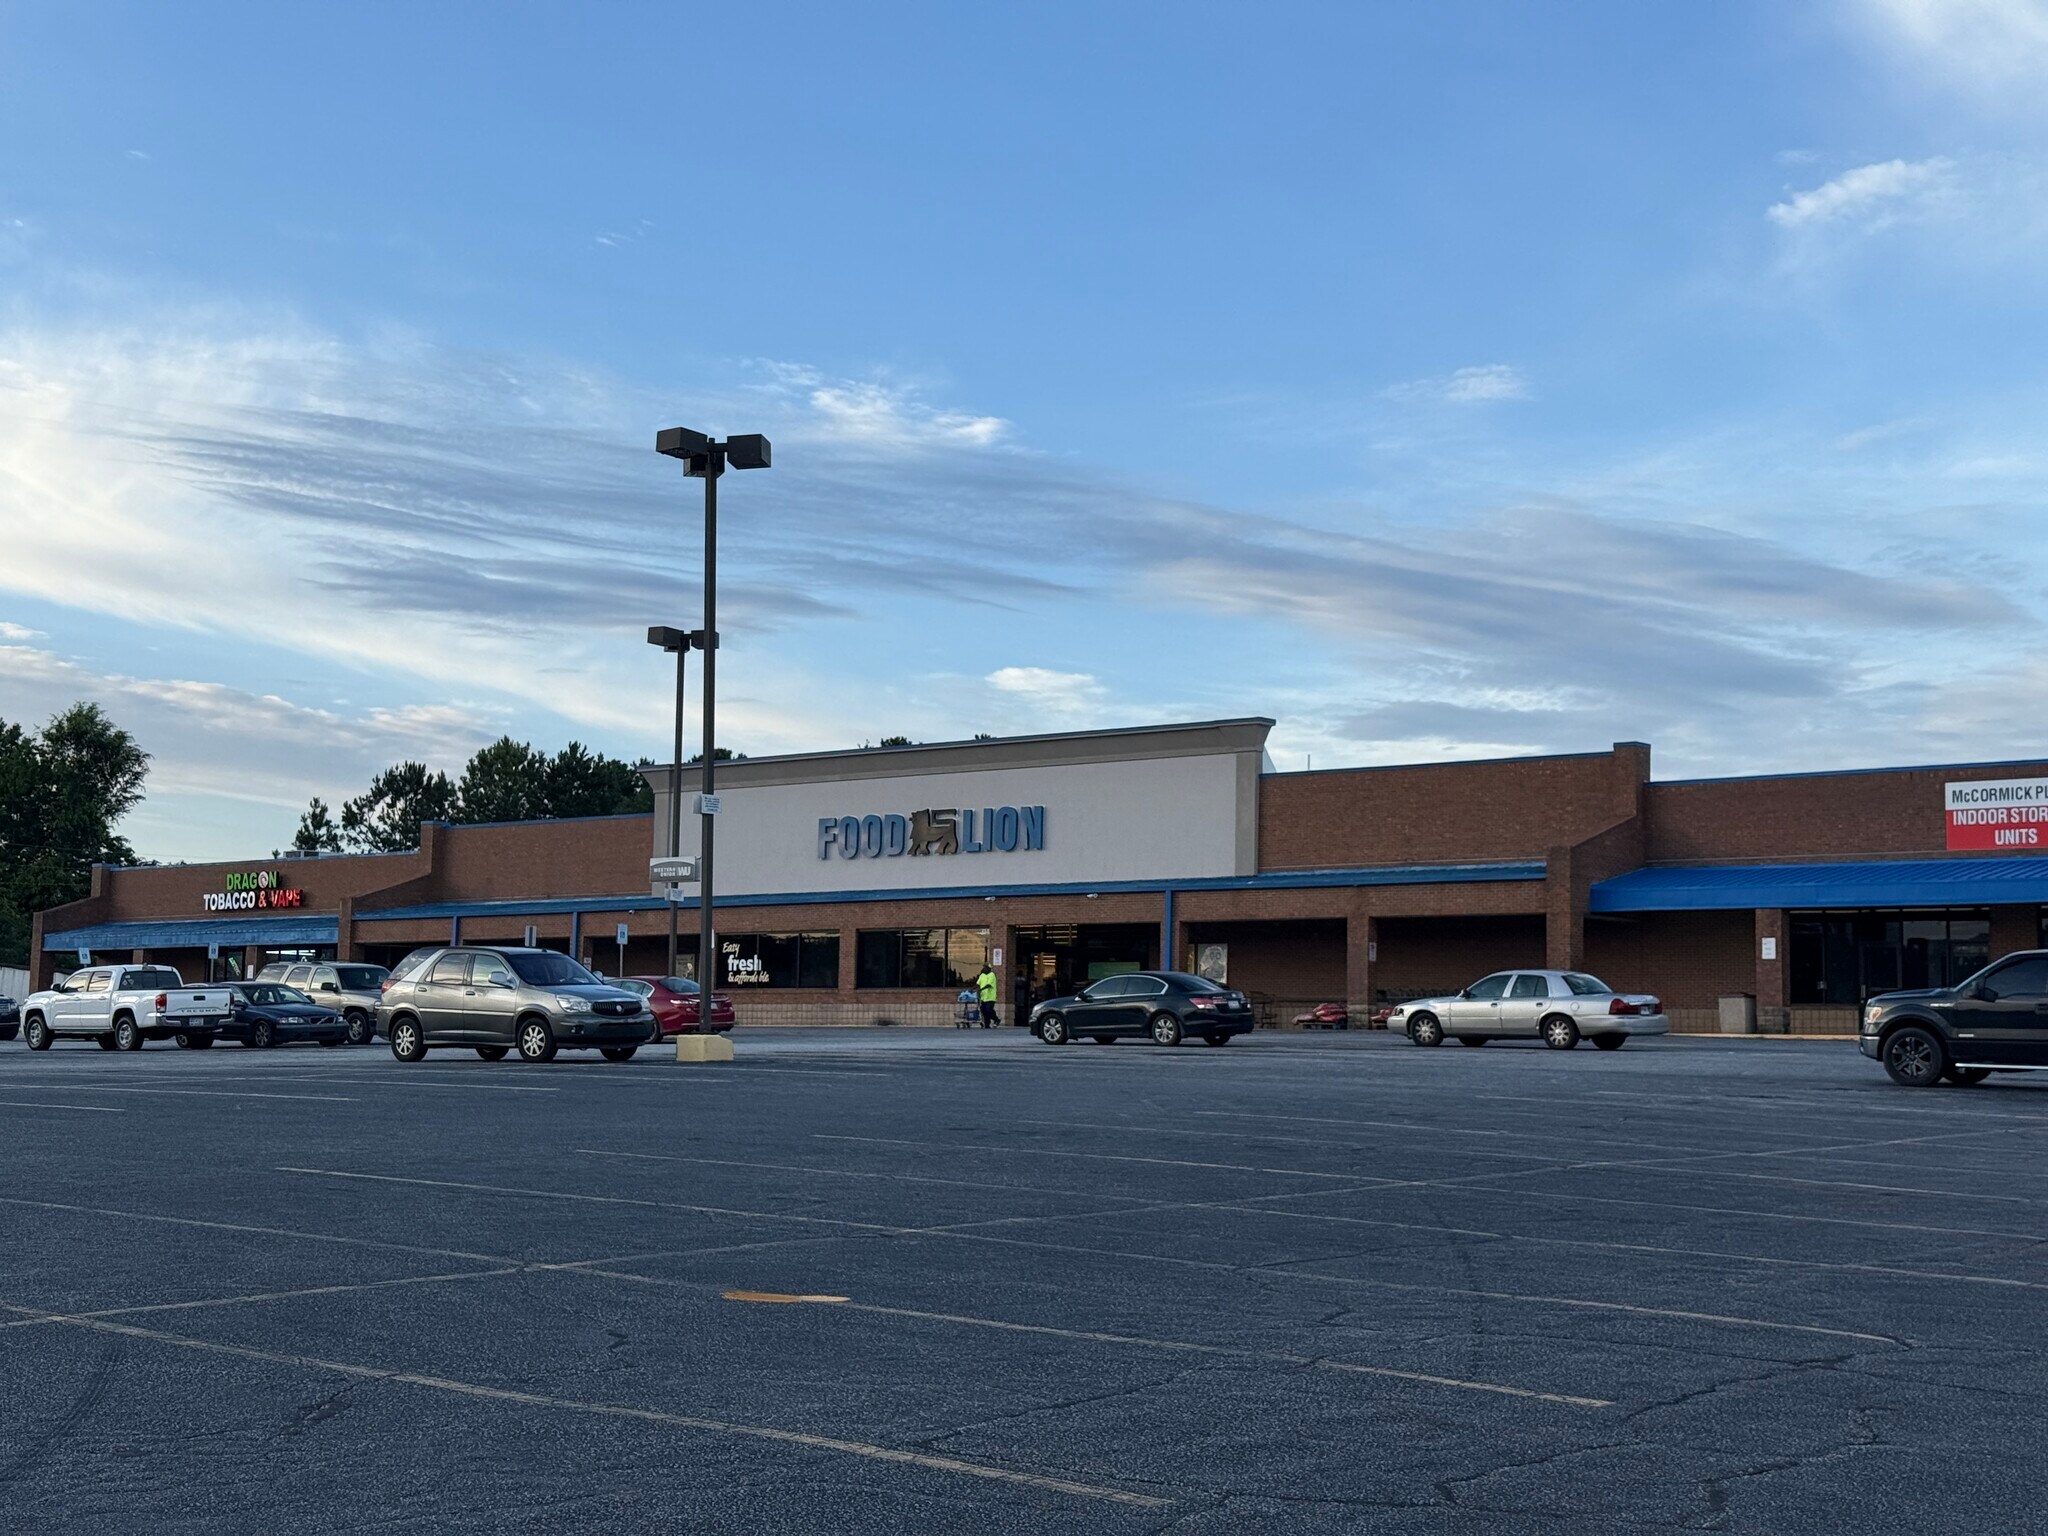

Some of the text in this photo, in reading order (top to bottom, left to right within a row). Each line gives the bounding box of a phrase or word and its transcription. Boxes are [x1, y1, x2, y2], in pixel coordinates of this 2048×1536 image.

[1952, 785, 2033, 803] McCORMICK
[1953, 808, 2007, 826] INDOOR
[818, 805, 1045, 860] FOOD LION
[1994, 828, 2038, 845] UNITS
[226, 871, 277, 890] DRAGON
[203, 889, 301, 911] TOBACCO & VAPE
[722, 941, 741, 958] Easy
[727, 954, 762, 971] fresh
